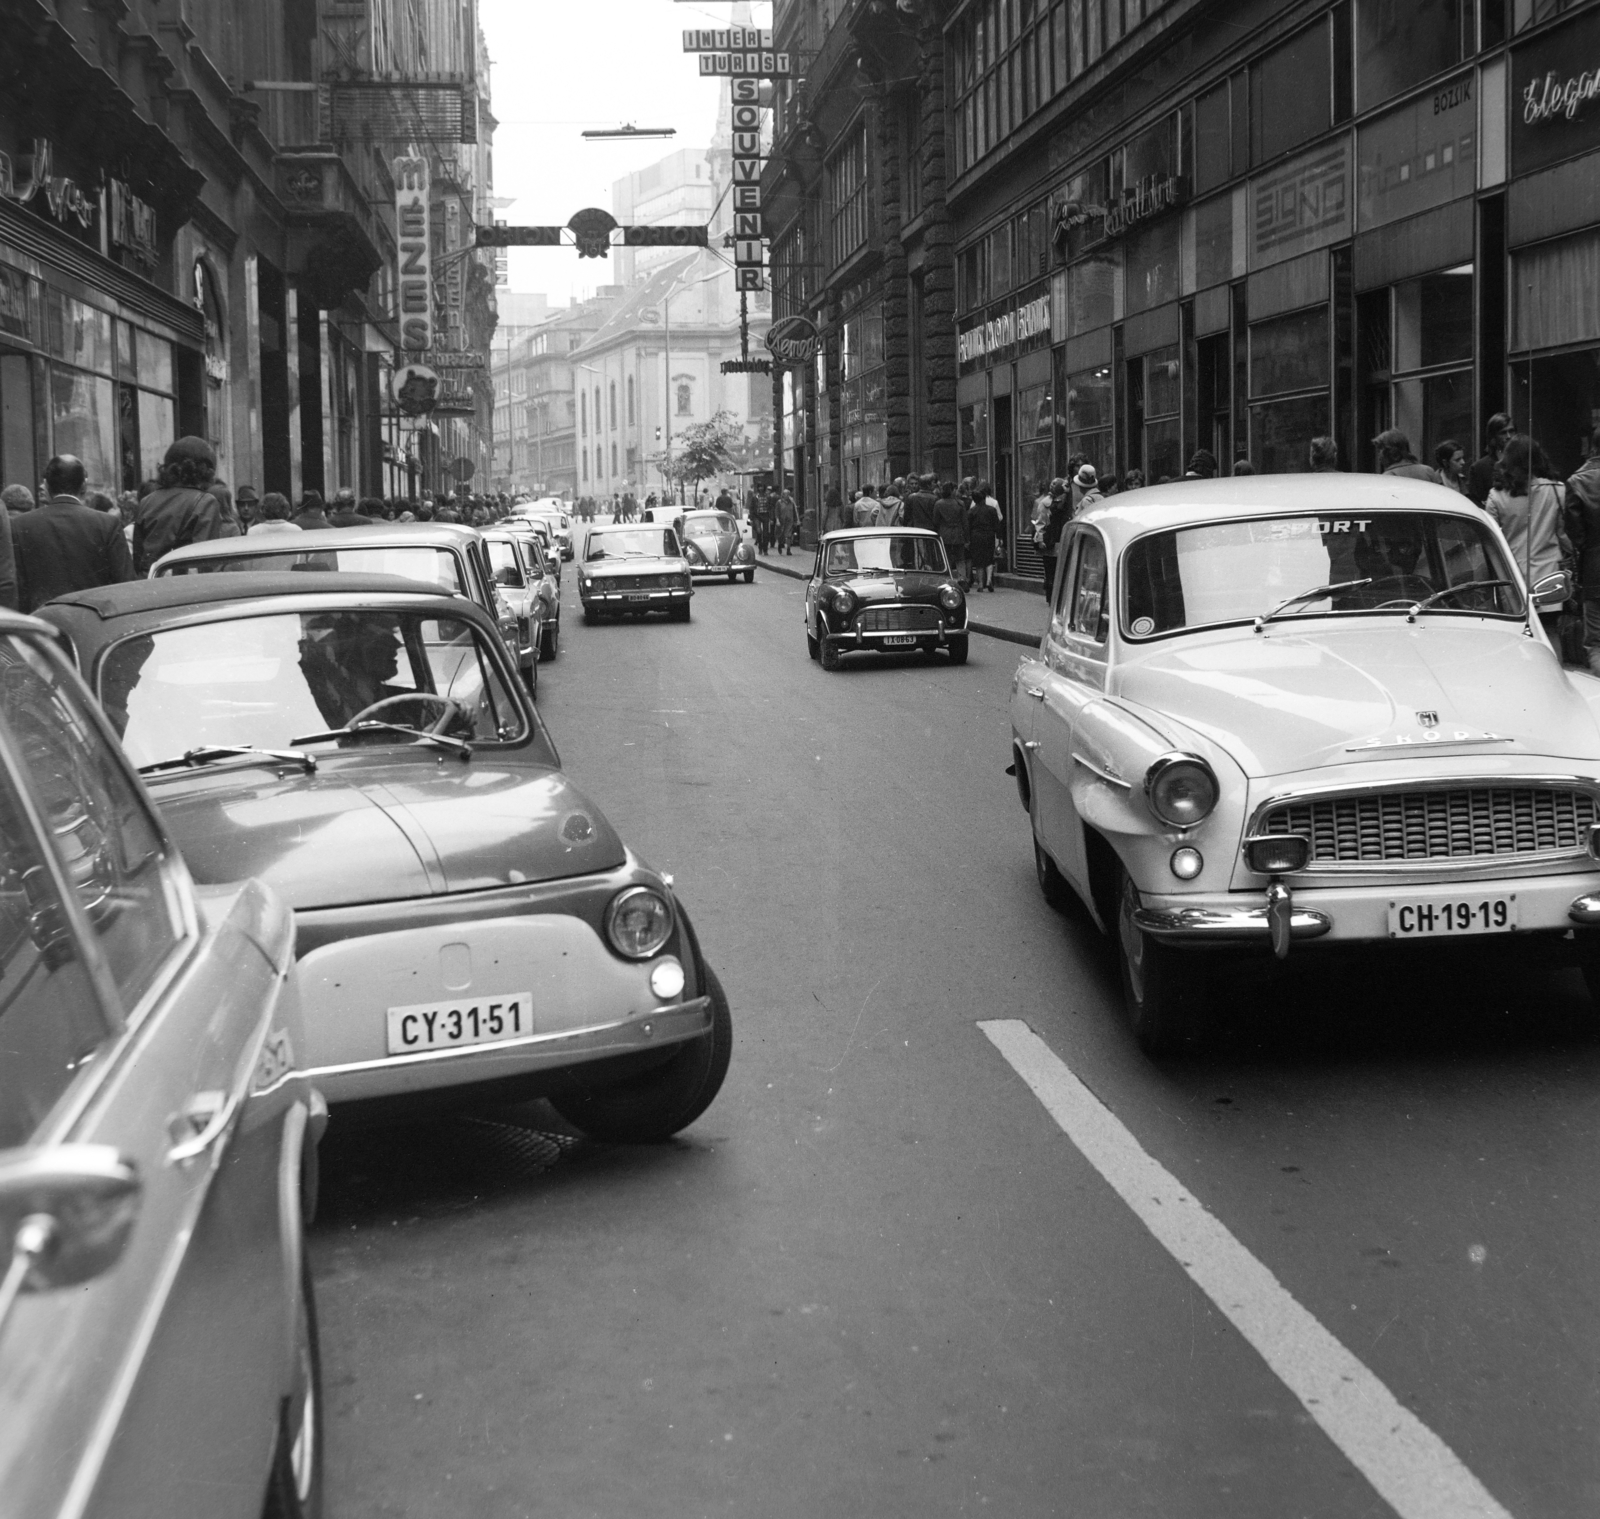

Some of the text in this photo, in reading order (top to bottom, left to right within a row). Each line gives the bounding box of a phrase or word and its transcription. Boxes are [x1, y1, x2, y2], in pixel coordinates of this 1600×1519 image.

[688, 31, 771, 47] INTER-
[702, 55, 788, 71] TURIST
[736, 79, 763, 290] SOUVENIR
[477, 227, 558, 244] ORION
[627, 227, 706, 244] ORION
[393, 157, 430, 350] MÉZES
[1270, 520, 1372, 539] SPORT
[1416, 711, 1436, 727] GT
[1399, 899, 1508, 932] CH-19-19
[401, 1001, 522, 1045] CY-31-51
